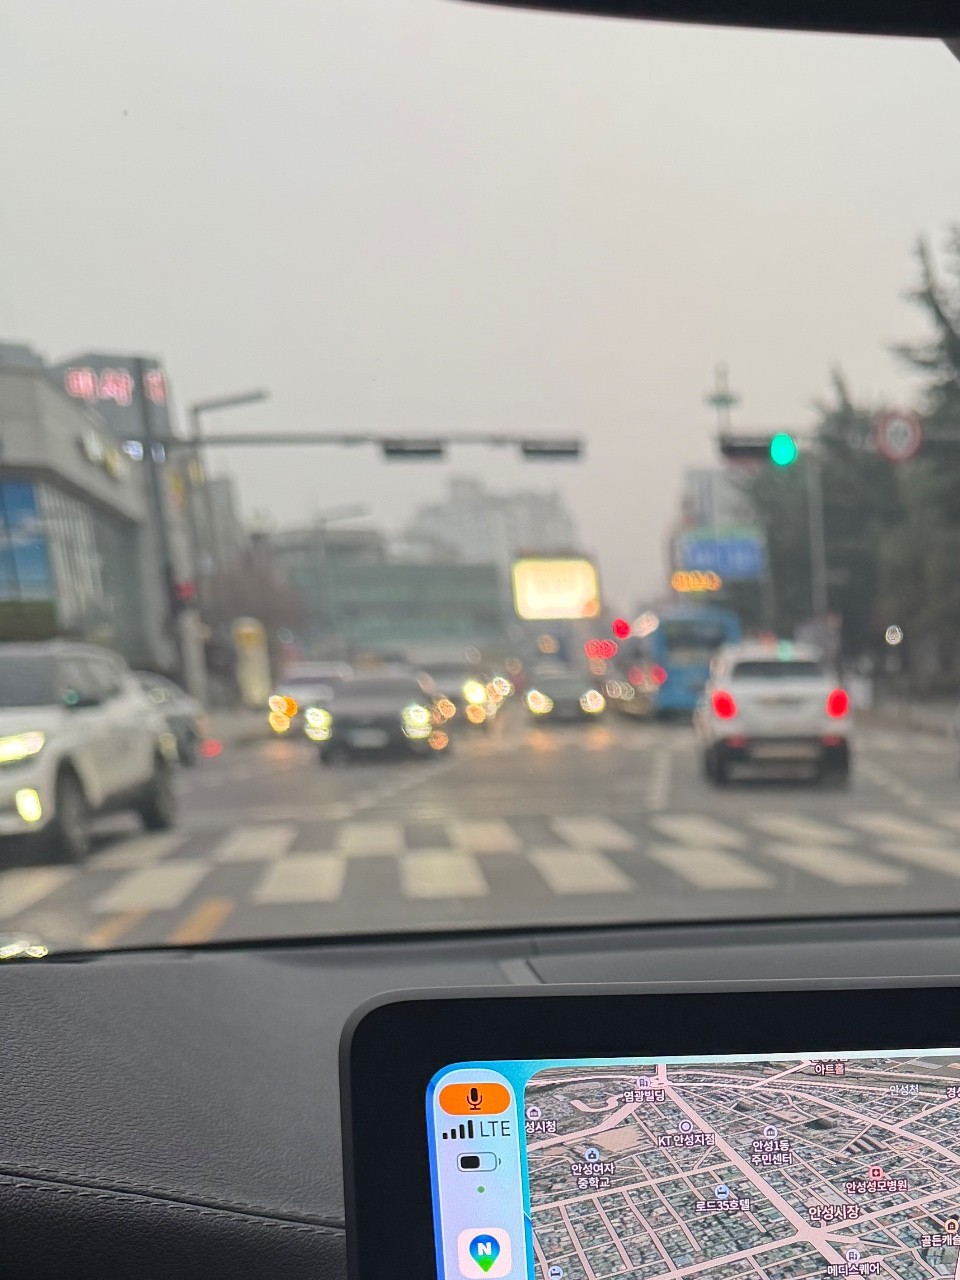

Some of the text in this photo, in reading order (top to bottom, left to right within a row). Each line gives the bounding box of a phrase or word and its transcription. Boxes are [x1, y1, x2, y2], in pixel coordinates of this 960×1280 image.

[624, 1089, 665, 1102] 염광빌딩
[889, 1084, 919, 1096] 안성천
[480, 1120, 511, 1137] LTE
[658, 1133, 715, 1147] KT 안성지점
[753, 1140, 790, 1152] 안성1동
[752, 1153, 793, 1165] 주민센터
[571, 1163, 615, 1175] 안성여자
[577, 1177, 611, 1189] 중학교
[845, 1180, 908, 1193] 안성성모병원
[696, 1199, 750, 1212] 로드35호텔
[808, 1204, 860, 1220] 안성시장
[477, 1241, 492, 1256] N
[828, 1263, 880, 1276] 메디스퀘어
